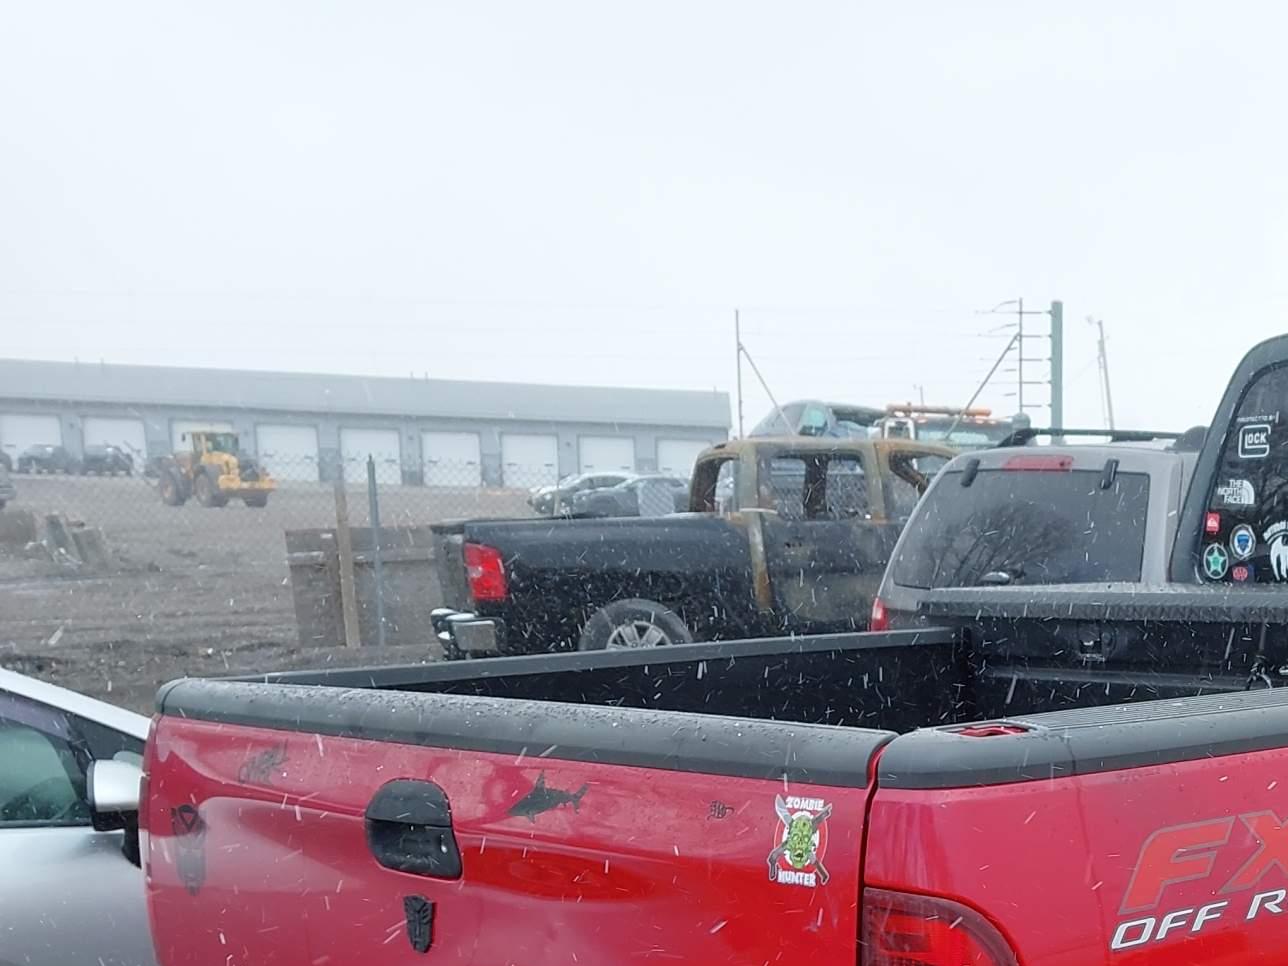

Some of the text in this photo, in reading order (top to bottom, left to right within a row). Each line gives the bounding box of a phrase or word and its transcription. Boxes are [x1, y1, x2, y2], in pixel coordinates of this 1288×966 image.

[785, 795, 825, 812] ZOMBIE
[776, 868, 817, 888] HUNTER
[1109, 900, 1229, 953] OFF
